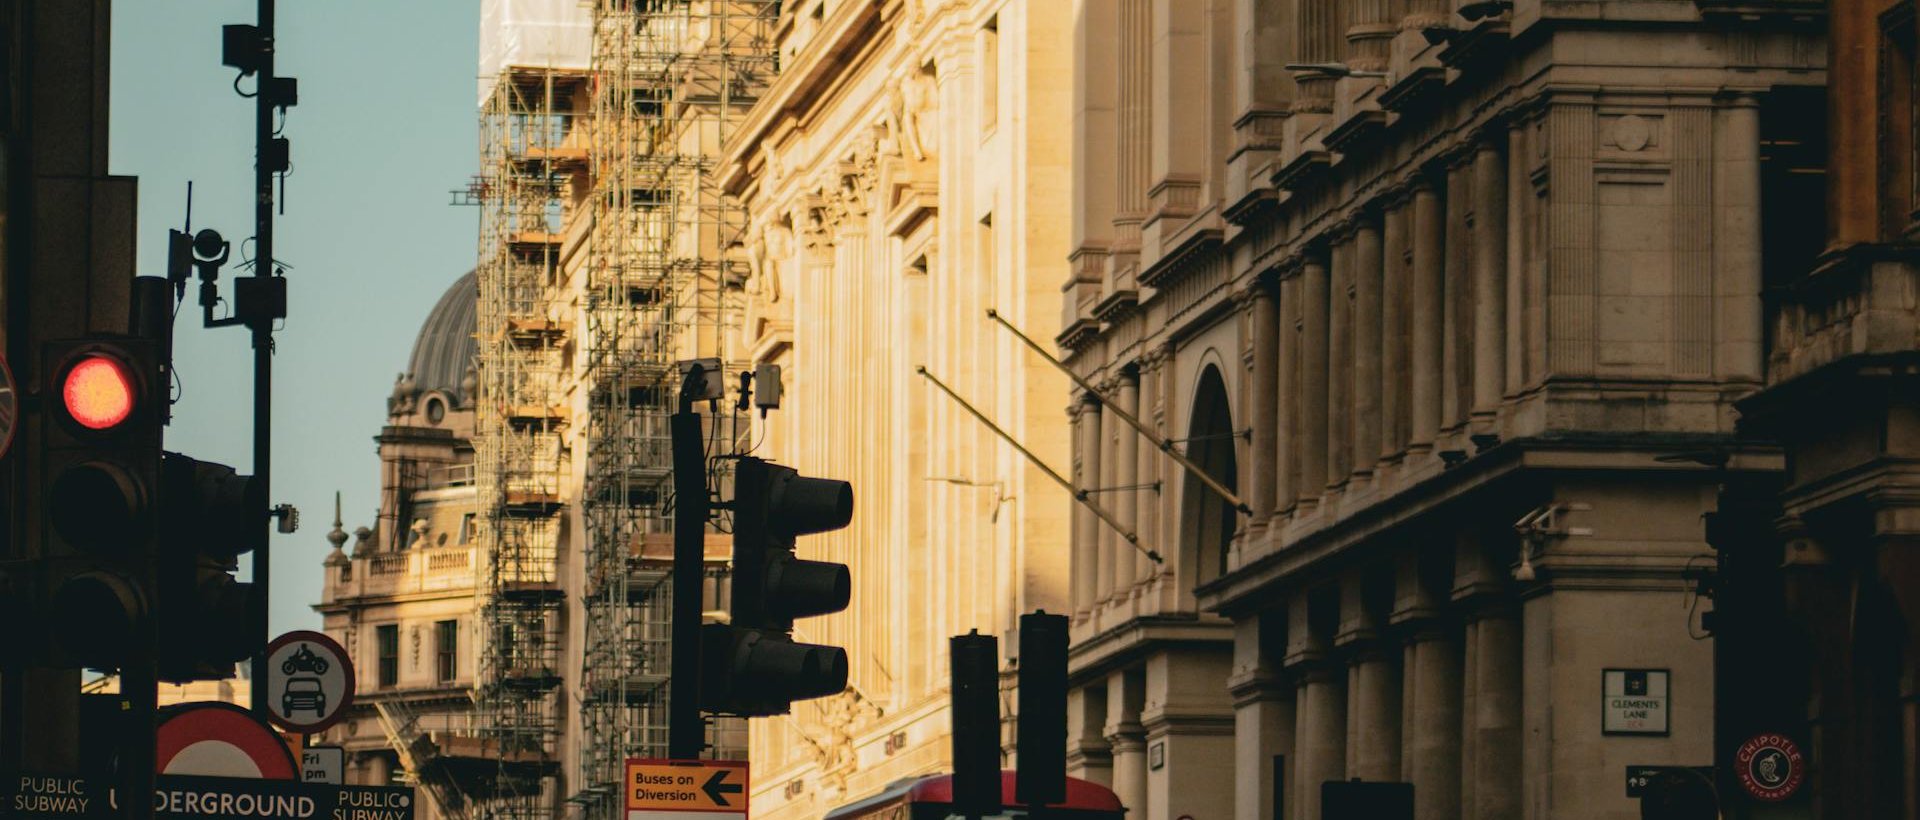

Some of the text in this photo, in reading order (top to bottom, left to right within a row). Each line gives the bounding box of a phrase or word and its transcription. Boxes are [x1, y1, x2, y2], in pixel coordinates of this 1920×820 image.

[1612, 700, 1659, 708] CLEMENTS
[1623, 710, 1648, 719] LANE
[1739, 735, 1801, 762] CHIPOTLE
[302, 753, 319, 765] Fri
[305, 770, 326, 781] pm
[635, 773, 694, 785] Buses on
[20, 777, 85, 795] PUBLIC
[338, 791, 400, 808] PUBLIC
[635, 789, 697, 801] Diversion
[15, 795, 89, 813] SUBWAY
[109, 788, 316, 819] DERGROUND
[332, 808, 405, 820] SUBWAY
